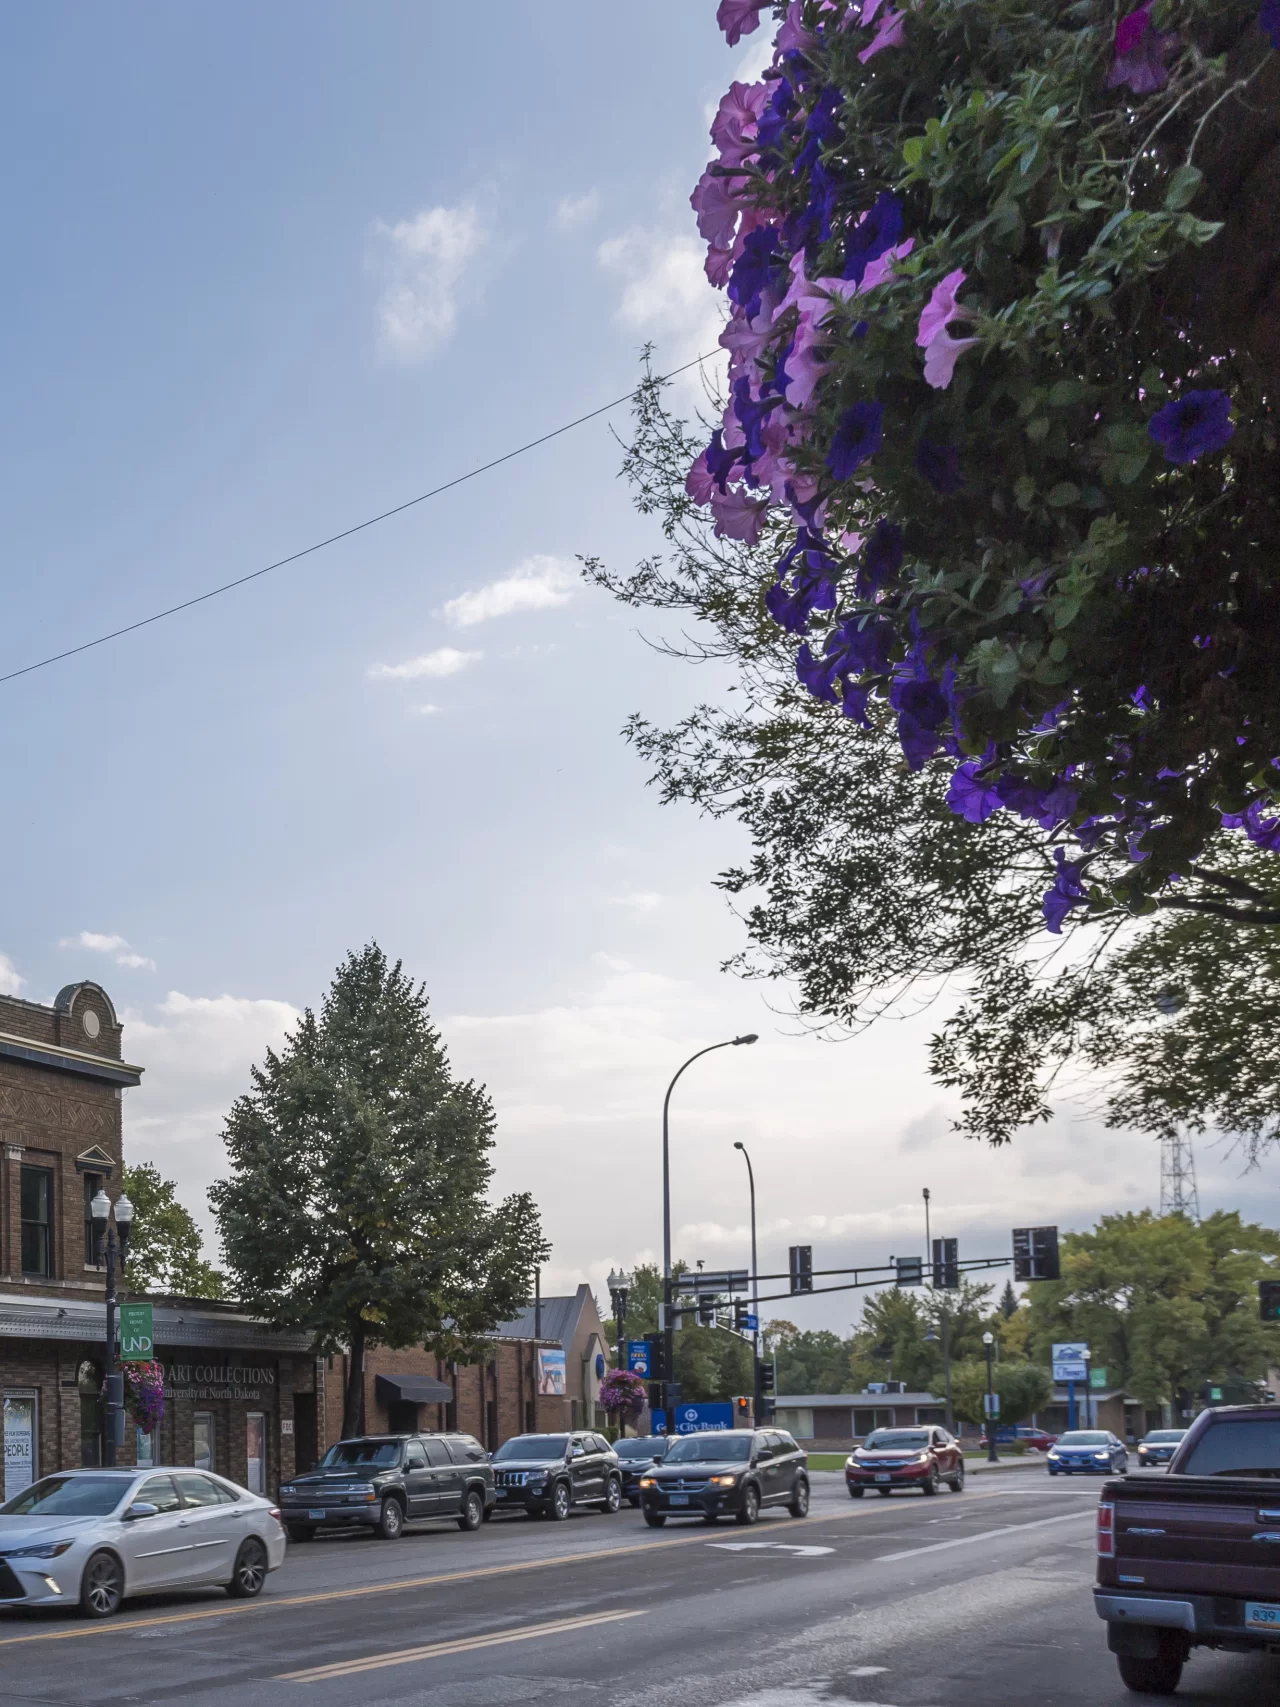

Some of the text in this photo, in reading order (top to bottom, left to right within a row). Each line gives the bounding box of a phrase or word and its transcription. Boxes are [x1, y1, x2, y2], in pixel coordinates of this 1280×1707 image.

[122, 1336, 152, 1352] UND
[168, 1363, 193, 1382] ART
[195, 1364, 275, 1385] COLLECTIONS
[164, 1386, 261, 1403] niversity of North Dakota
[680, 1422, 700, 1432] City
[700, 1421, 728, 1431] Bank
[4, 1444, 30, 1457] PEOPLE
[1252, 1609, 1277, 1622] 839
